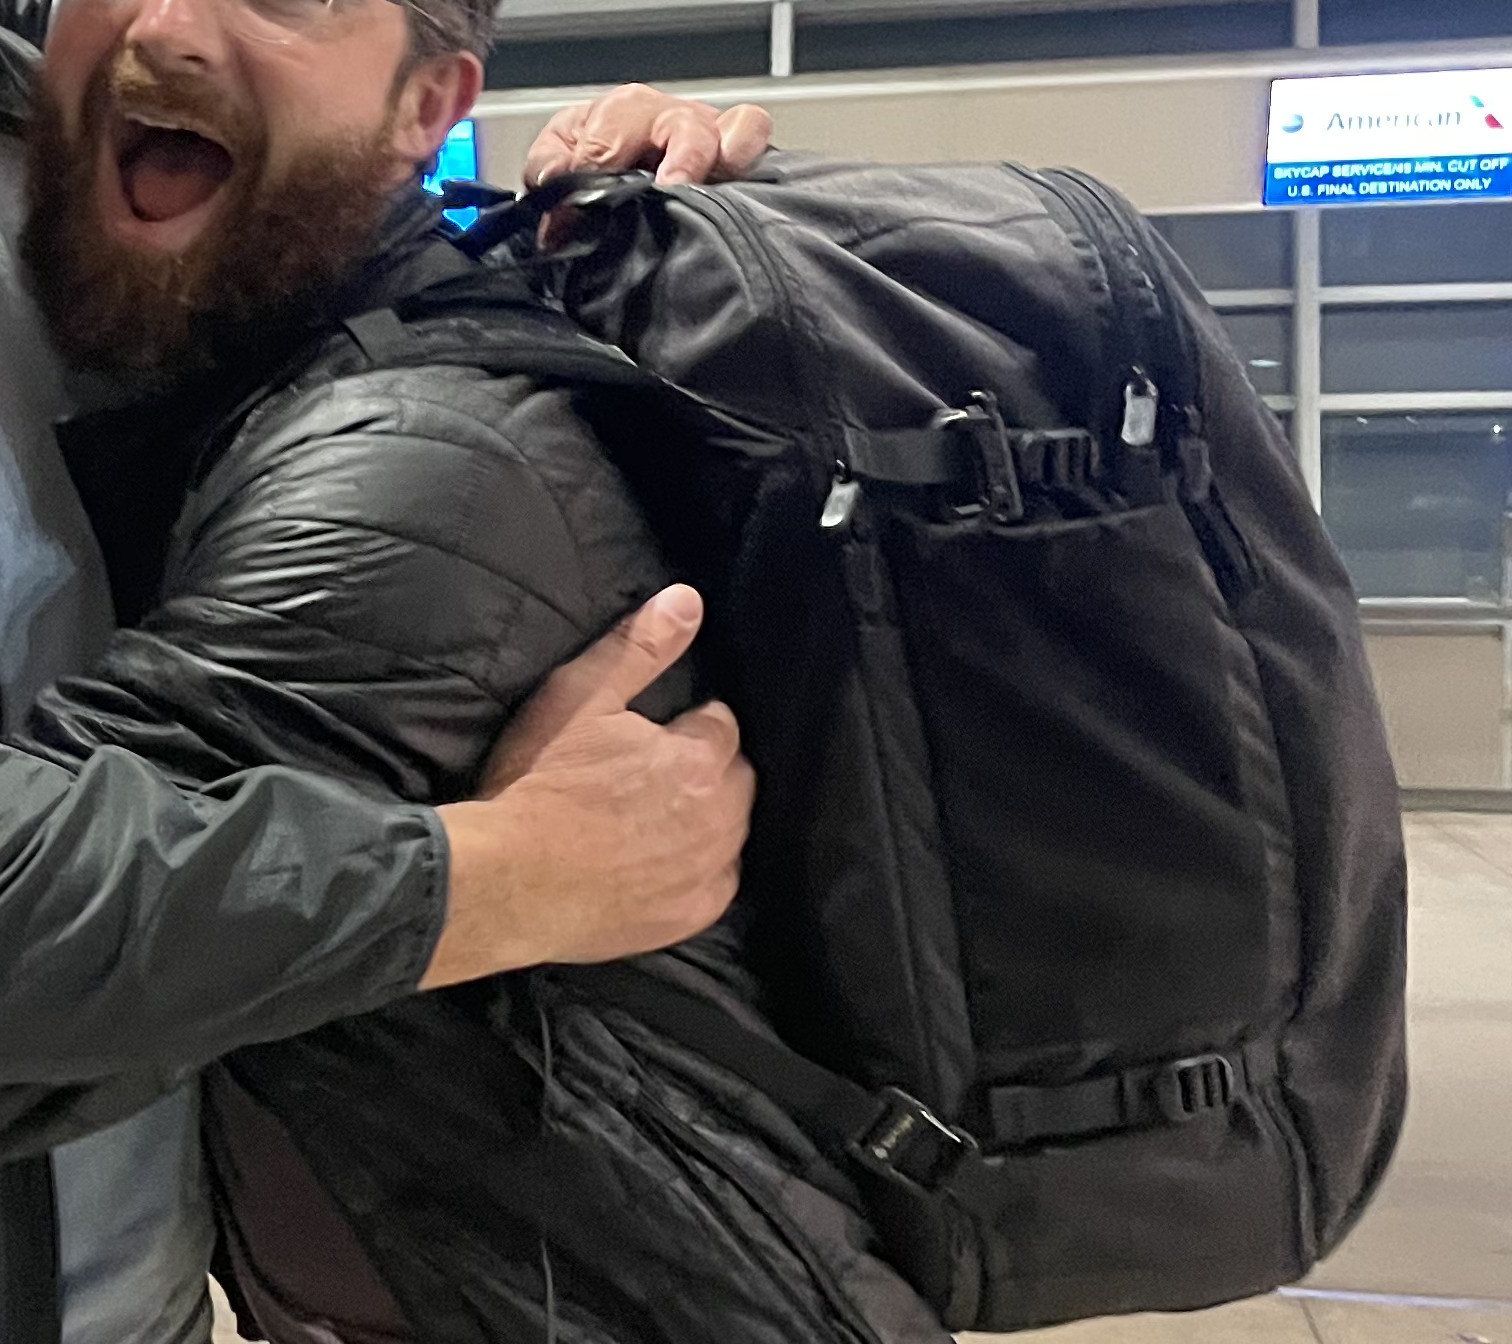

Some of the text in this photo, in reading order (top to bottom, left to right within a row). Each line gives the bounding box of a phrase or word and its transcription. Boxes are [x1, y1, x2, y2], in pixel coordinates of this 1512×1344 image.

[1326, 111, 1461, 131] American
[1274, 165, 1329, 179] SKYCAP
[1447, 159, 1478, 173] CUT
[1479, 157, 1509, 171] OFF
[1317, 182, 1356, 196] FINAL
[1359, 179, 1451, 195] DESTINATION
[1453, 176, 1492, 191] ONLY
